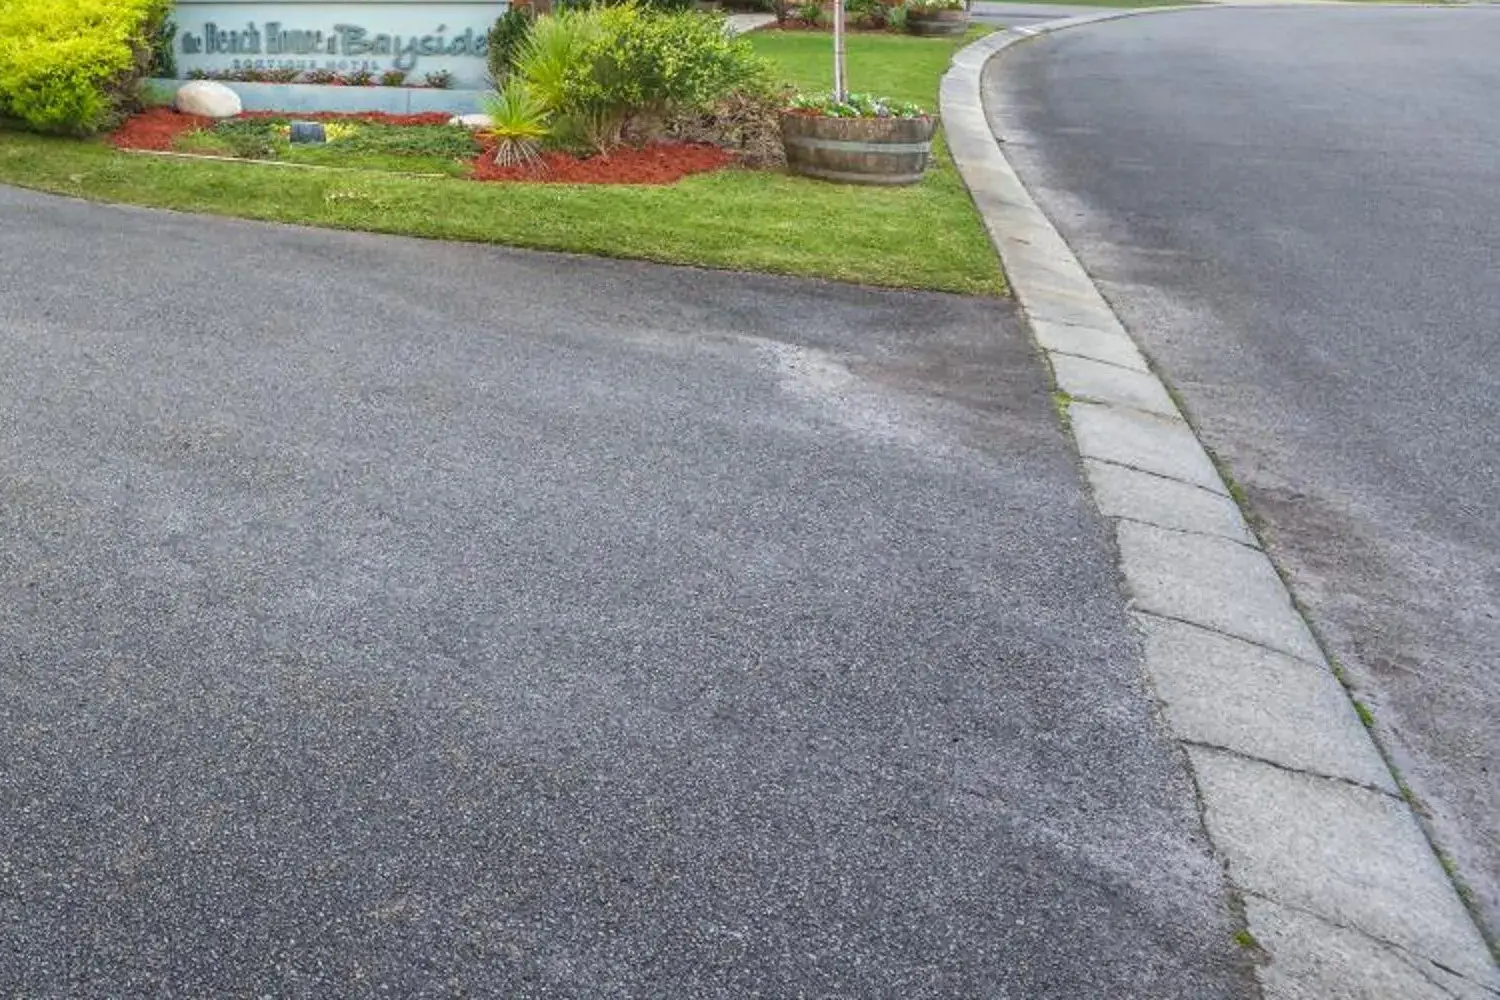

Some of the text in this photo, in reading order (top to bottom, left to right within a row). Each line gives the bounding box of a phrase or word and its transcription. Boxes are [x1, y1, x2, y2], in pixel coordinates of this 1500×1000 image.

[205, 21, 261, 55] Beach
[265, 21, 323, 55] House
[333, 23, 489, 71] Bayside
[233, 58, 380, 71] BOUTIQUE HOTEL
